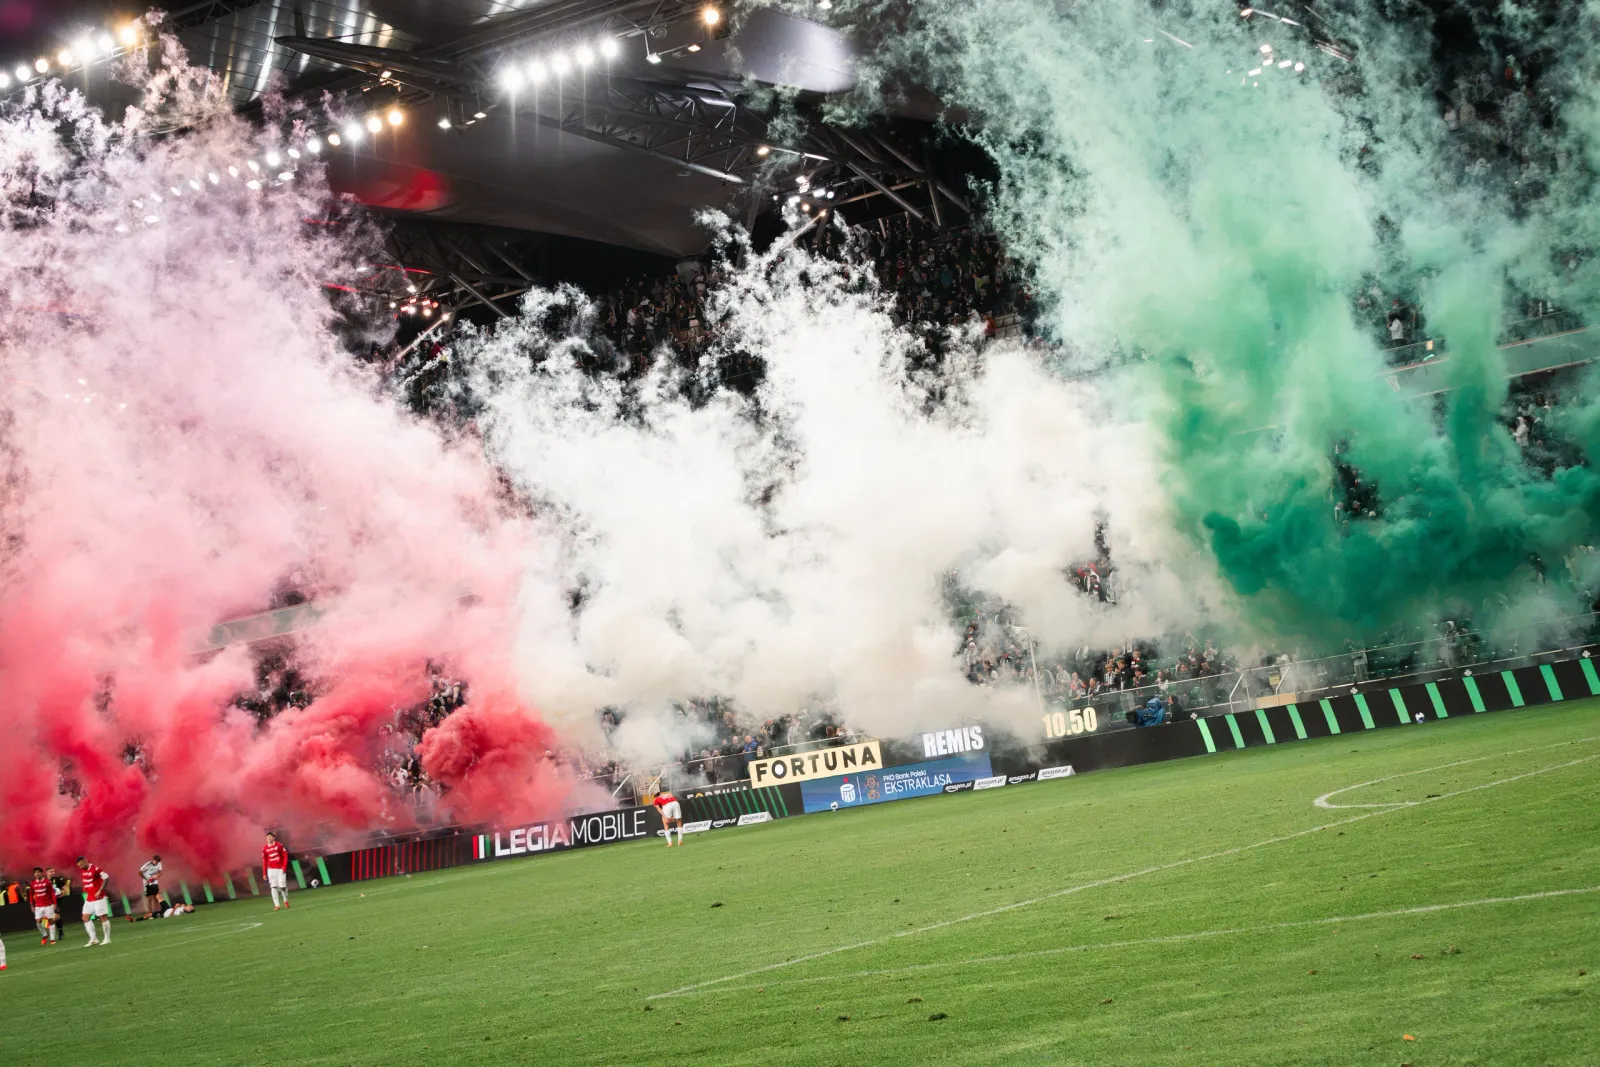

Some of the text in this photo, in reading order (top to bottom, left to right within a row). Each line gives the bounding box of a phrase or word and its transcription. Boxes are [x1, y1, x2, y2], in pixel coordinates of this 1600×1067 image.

[1042, 707, 1098, 738] 10.50
[923, 726, 984, 757] REMIS
[755, 746, 877, 782] FORTUNA
[910, 769, 927, 778] Polski
[1041, 768, 1068, 777] amazon.pl
[1008, 773, 1036, 783] amazon.pl
[884, 773, 952, 794] EKSTRAKLASA
[945, 782, 972, 792] amazon.pl
[741, 814, 765, 823] amazon.pl
[685, 821, 709, 831] amazon.pl
